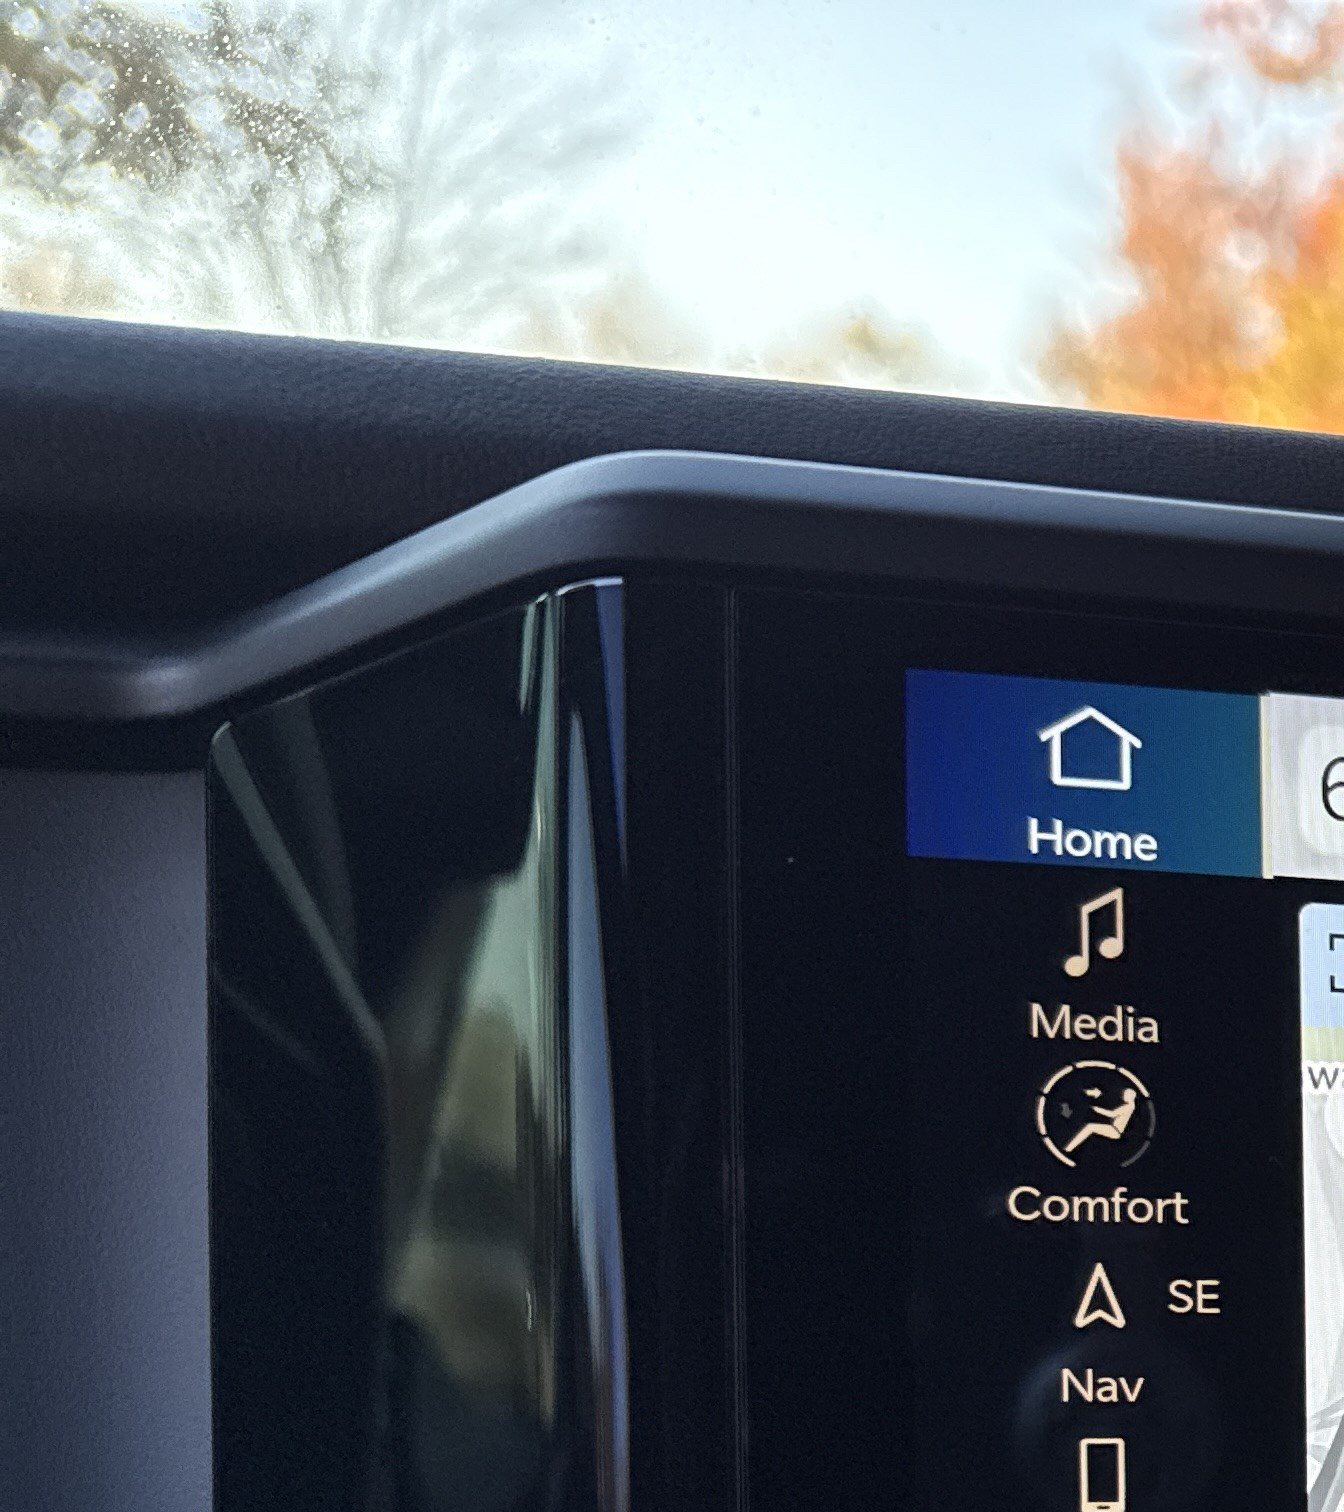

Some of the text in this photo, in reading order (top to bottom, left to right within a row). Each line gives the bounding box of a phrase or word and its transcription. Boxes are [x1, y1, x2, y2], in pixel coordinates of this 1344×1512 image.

[1027, 816, 1158, 861] Home
[1030, 1002, 1160, 1043] Media
[1007, 1185, 1190, 1225] Comfort
[1168, 1279, 1221, 1314] SE
[1062, 1368, 1145, 1403] Nav
